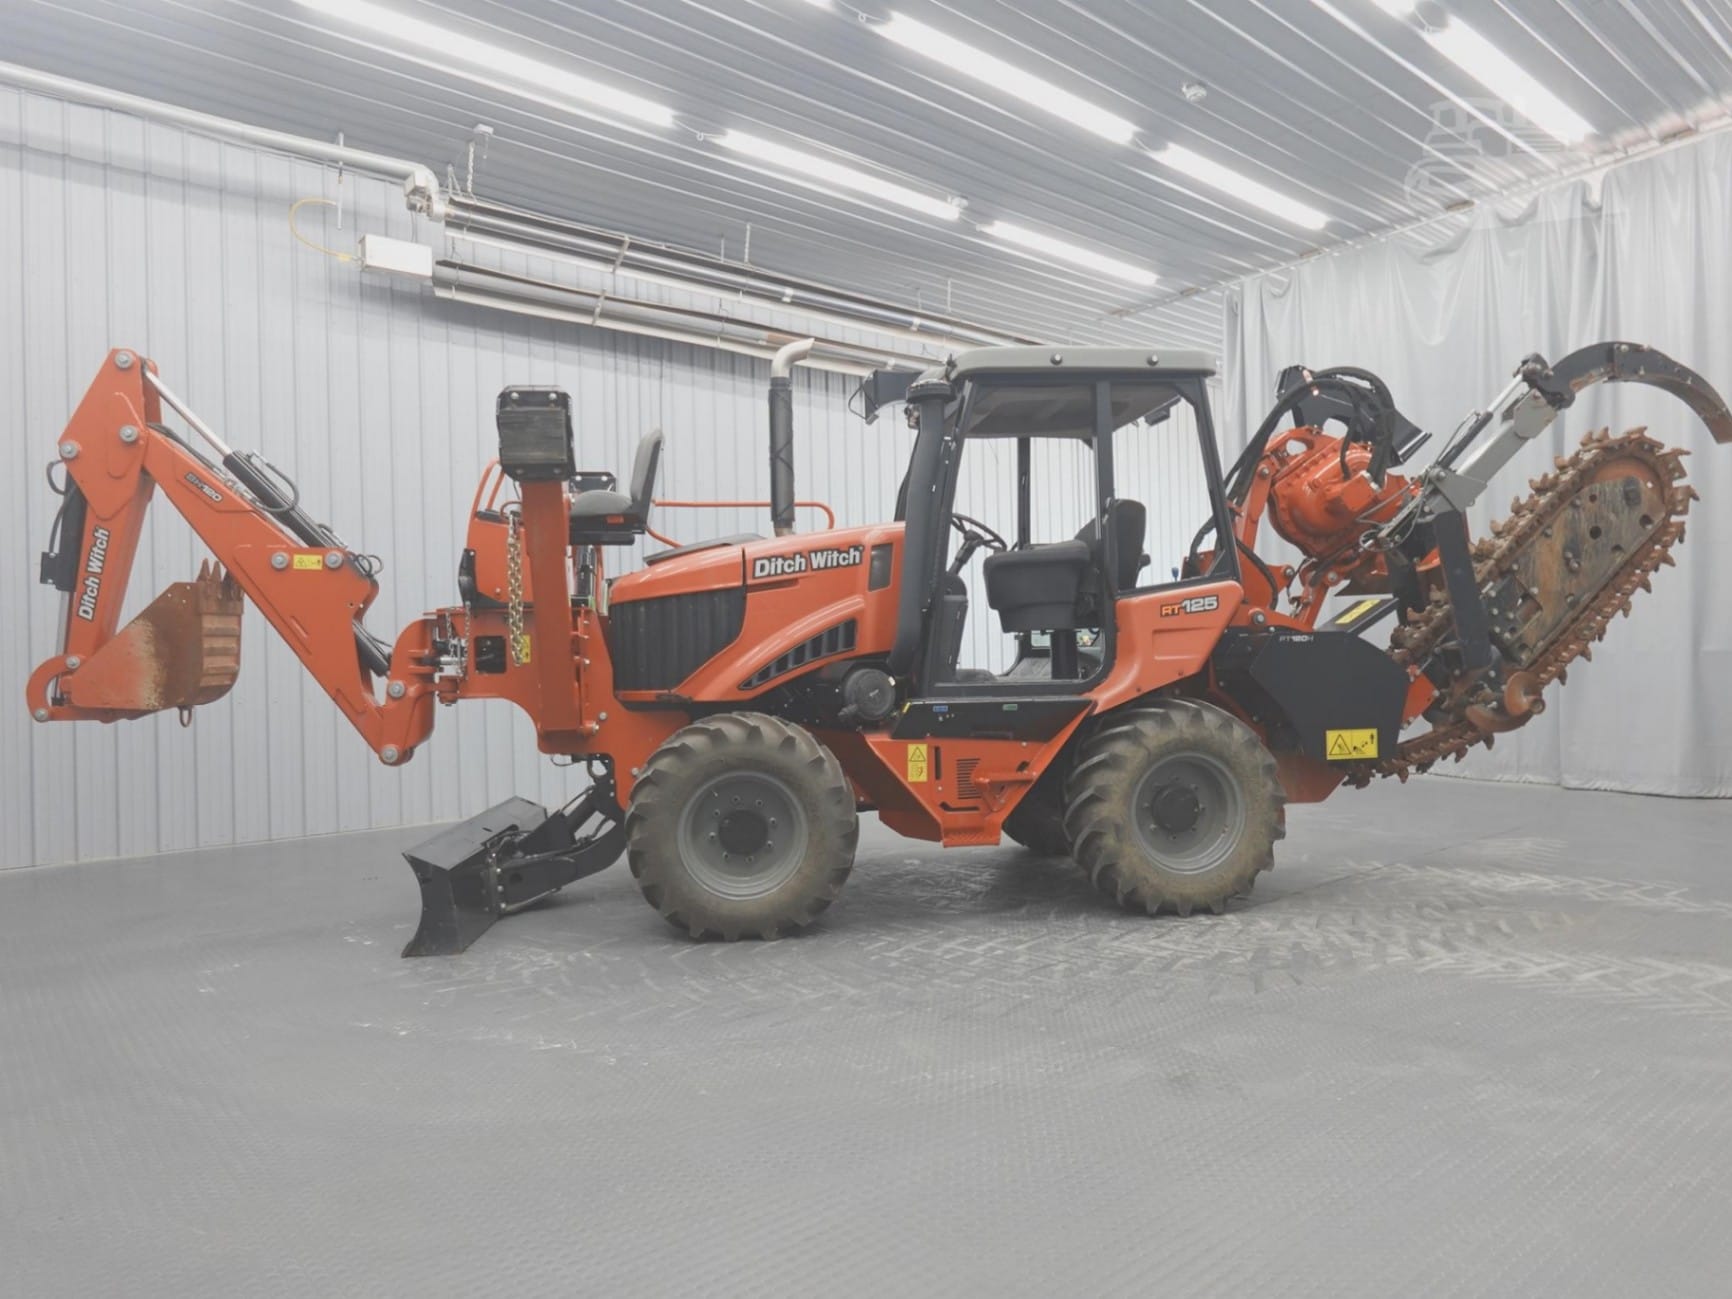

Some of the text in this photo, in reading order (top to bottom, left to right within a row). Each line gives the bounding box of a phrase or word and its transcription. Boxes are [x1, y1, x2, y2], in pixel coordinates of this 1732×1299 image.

[78, 527, 109, 620] Ditch Witch
[754, 547, 861, 578] Ditch Witch
[1161, 596, 1218, 616] RT125
